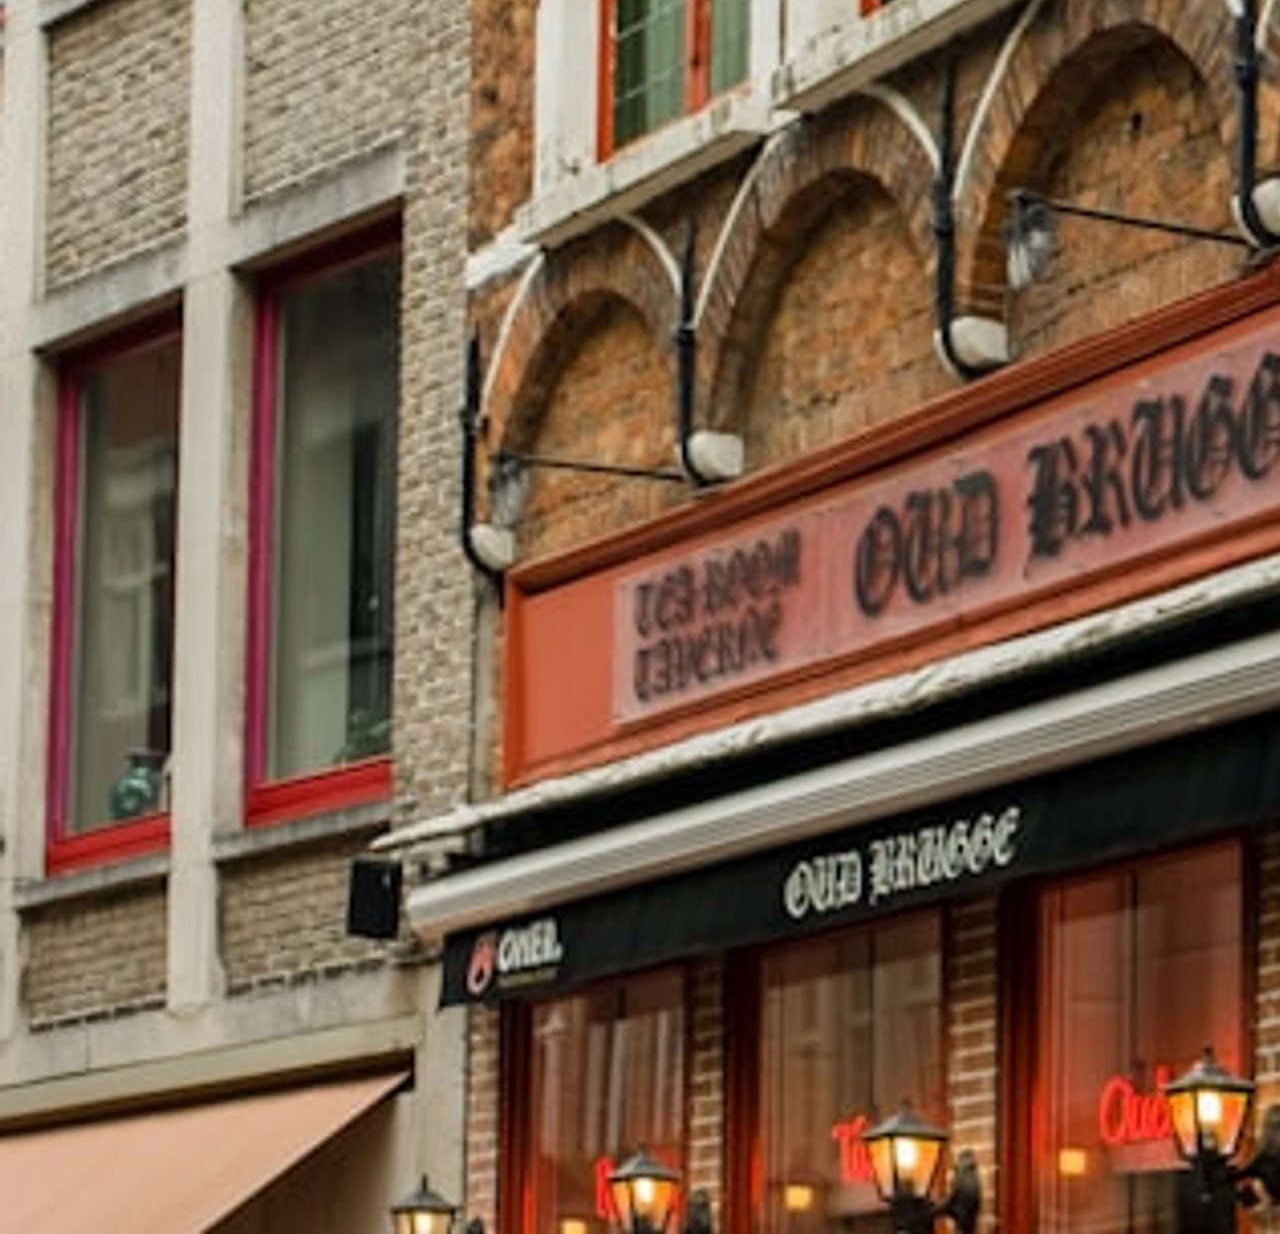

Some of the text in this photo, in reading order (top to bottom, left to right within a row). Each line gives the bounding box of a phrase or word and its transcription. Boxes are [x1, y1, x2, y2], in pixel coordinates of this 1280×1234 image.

[854, 469, 998, 618] OUD
[634, 565, 694, 639] TEA
[784, 806, 1021, 918] OUD BRUGGE
